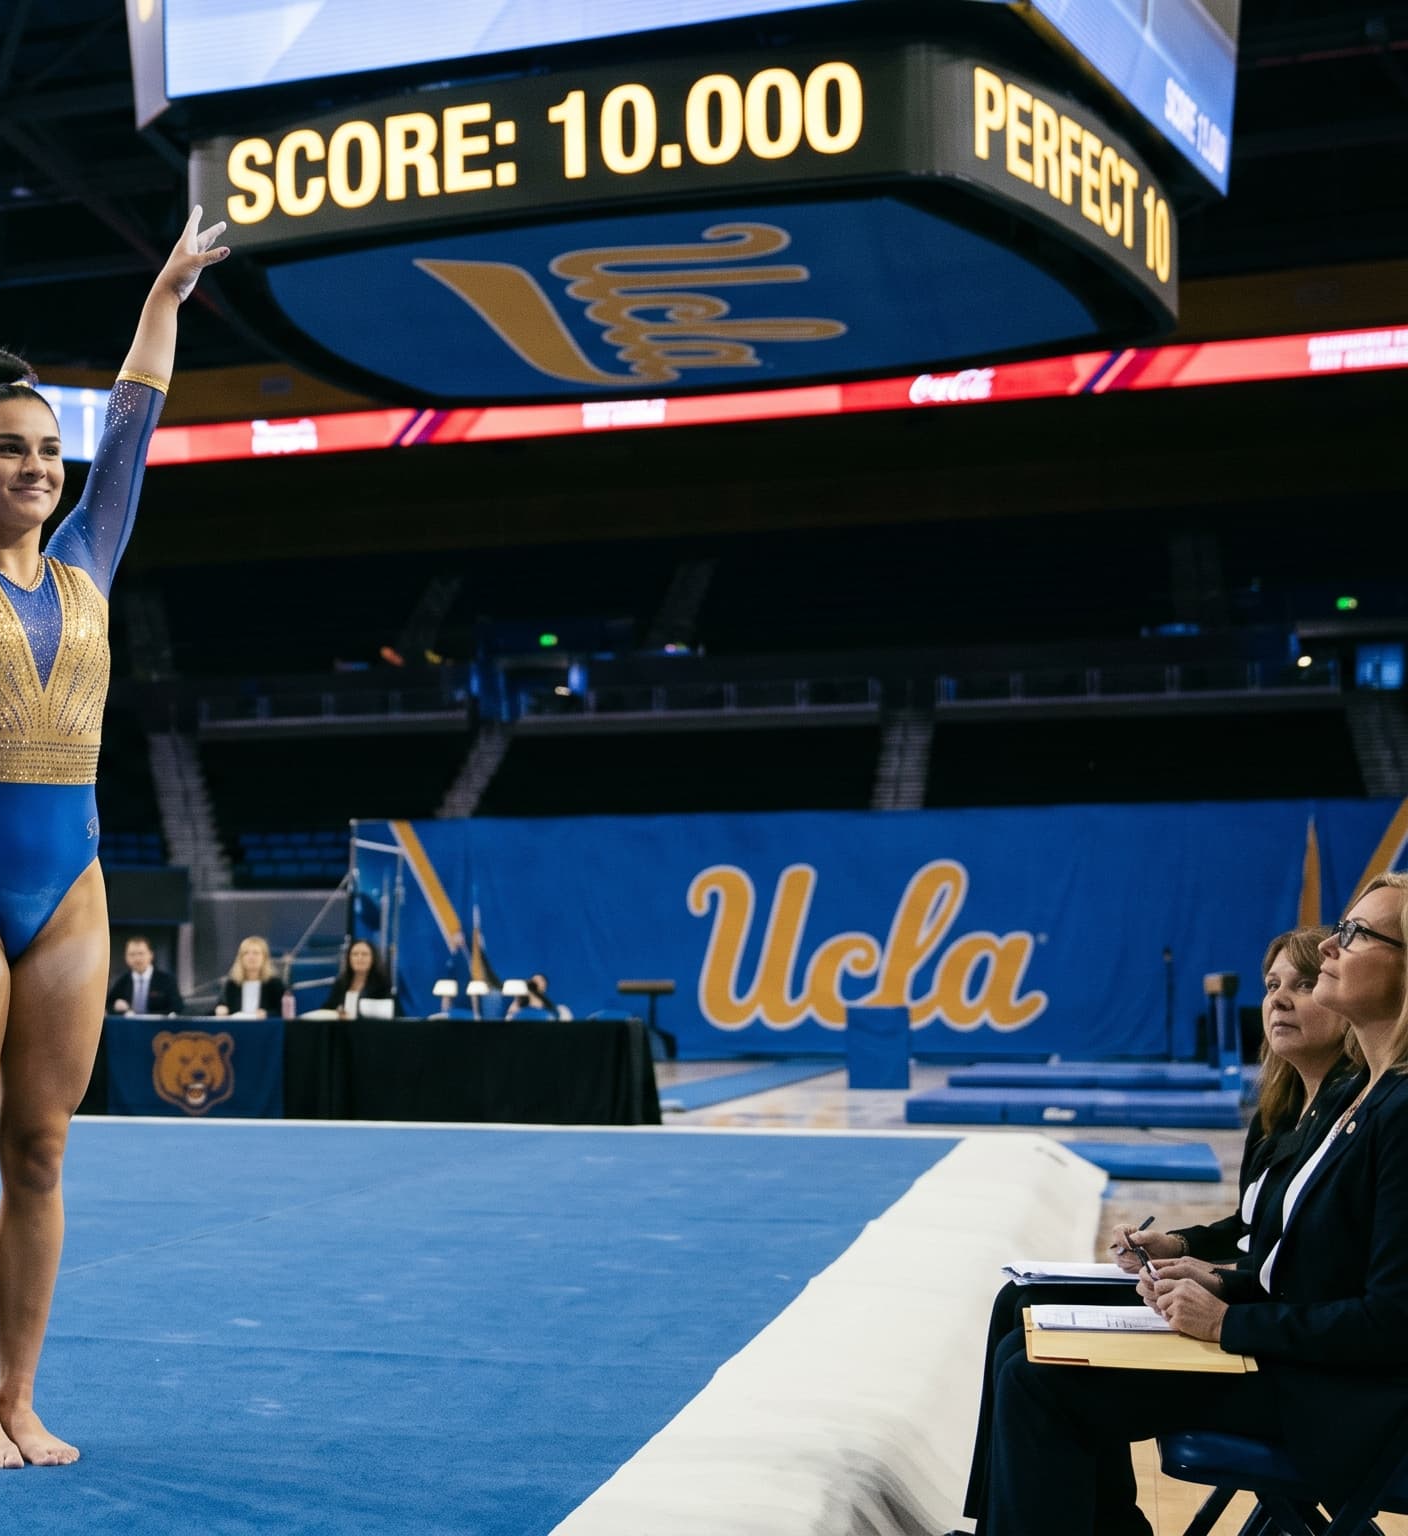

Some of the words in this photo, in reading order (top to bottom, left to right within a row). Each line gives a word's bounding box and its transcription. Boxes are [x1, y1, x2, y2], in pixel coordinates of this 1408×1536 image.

[226, 102, 517, 225] SCORE:
[547, 61, 864, 181] 10.000
[973, 66, 1139, 249] PERFECT
[1143, 185, 1171, 284] 10
[687, 859, 1049, 1032] Ucla
